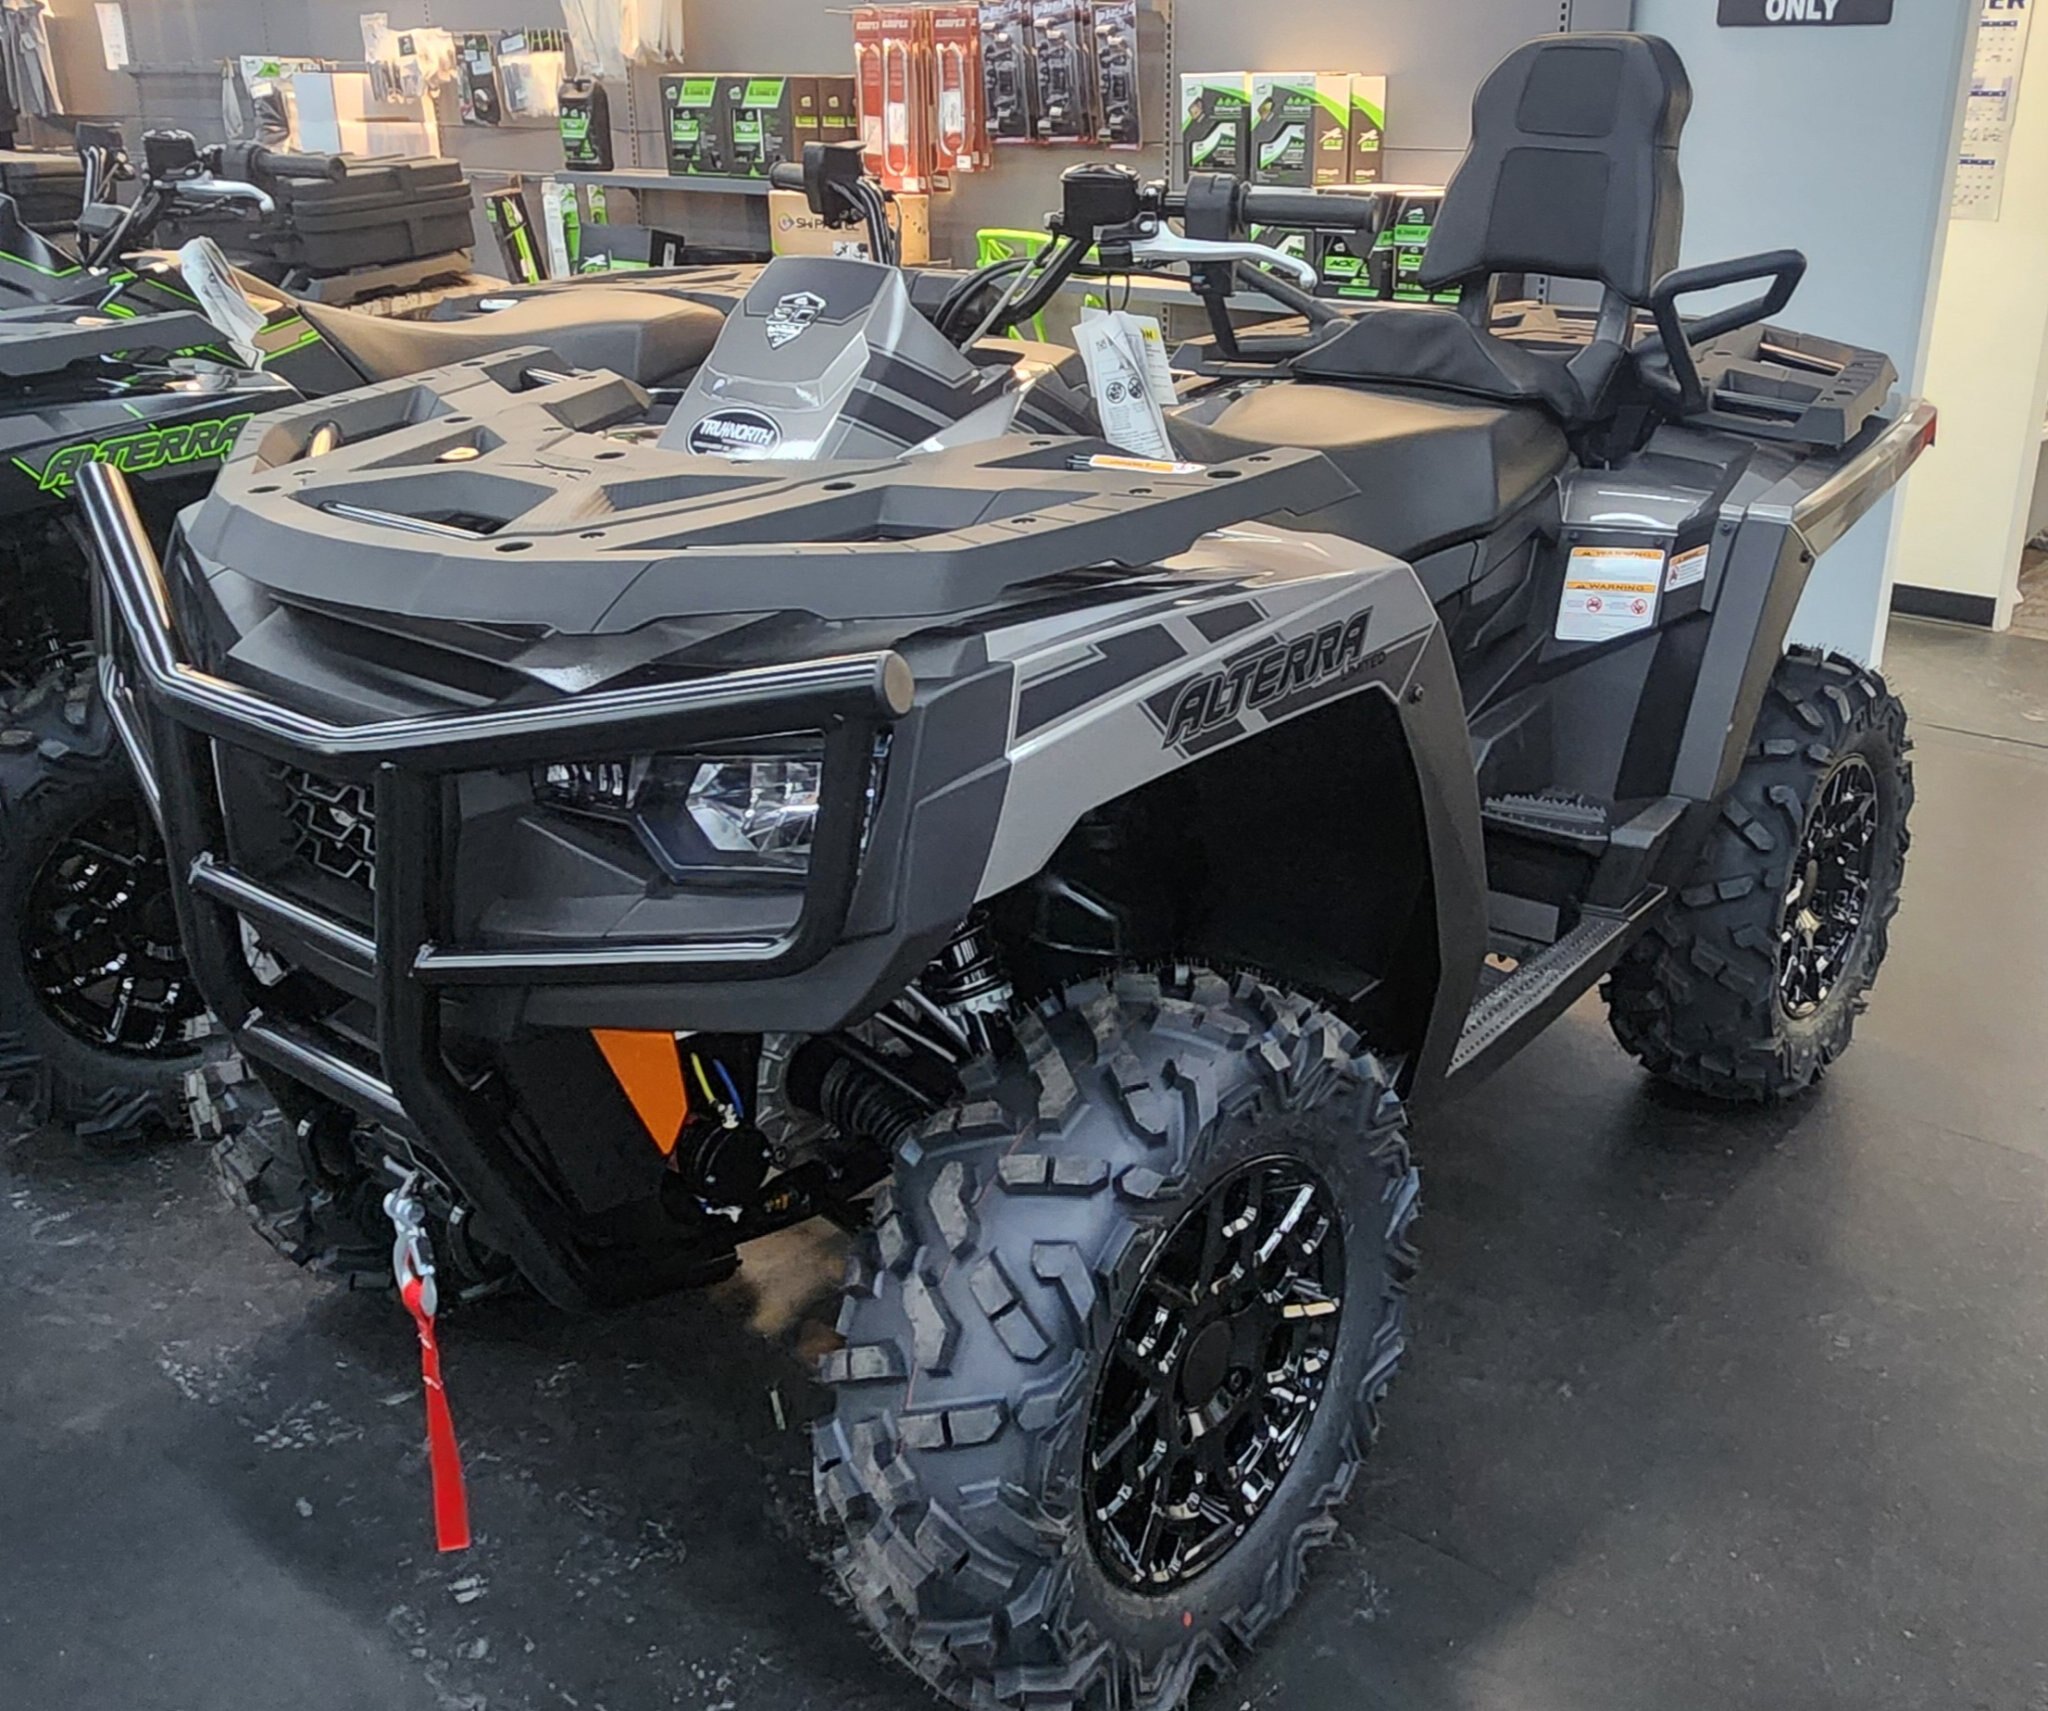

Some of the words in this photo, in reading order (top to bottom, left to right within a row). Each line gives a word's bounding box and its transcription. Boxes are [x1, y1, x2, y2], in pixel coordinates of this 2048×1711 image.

[1765, 0, 1837, 20] ONLY
[1589, 583, 1645, 592] WARNING
[1161, 605, 1374, 750] ALTERRA
